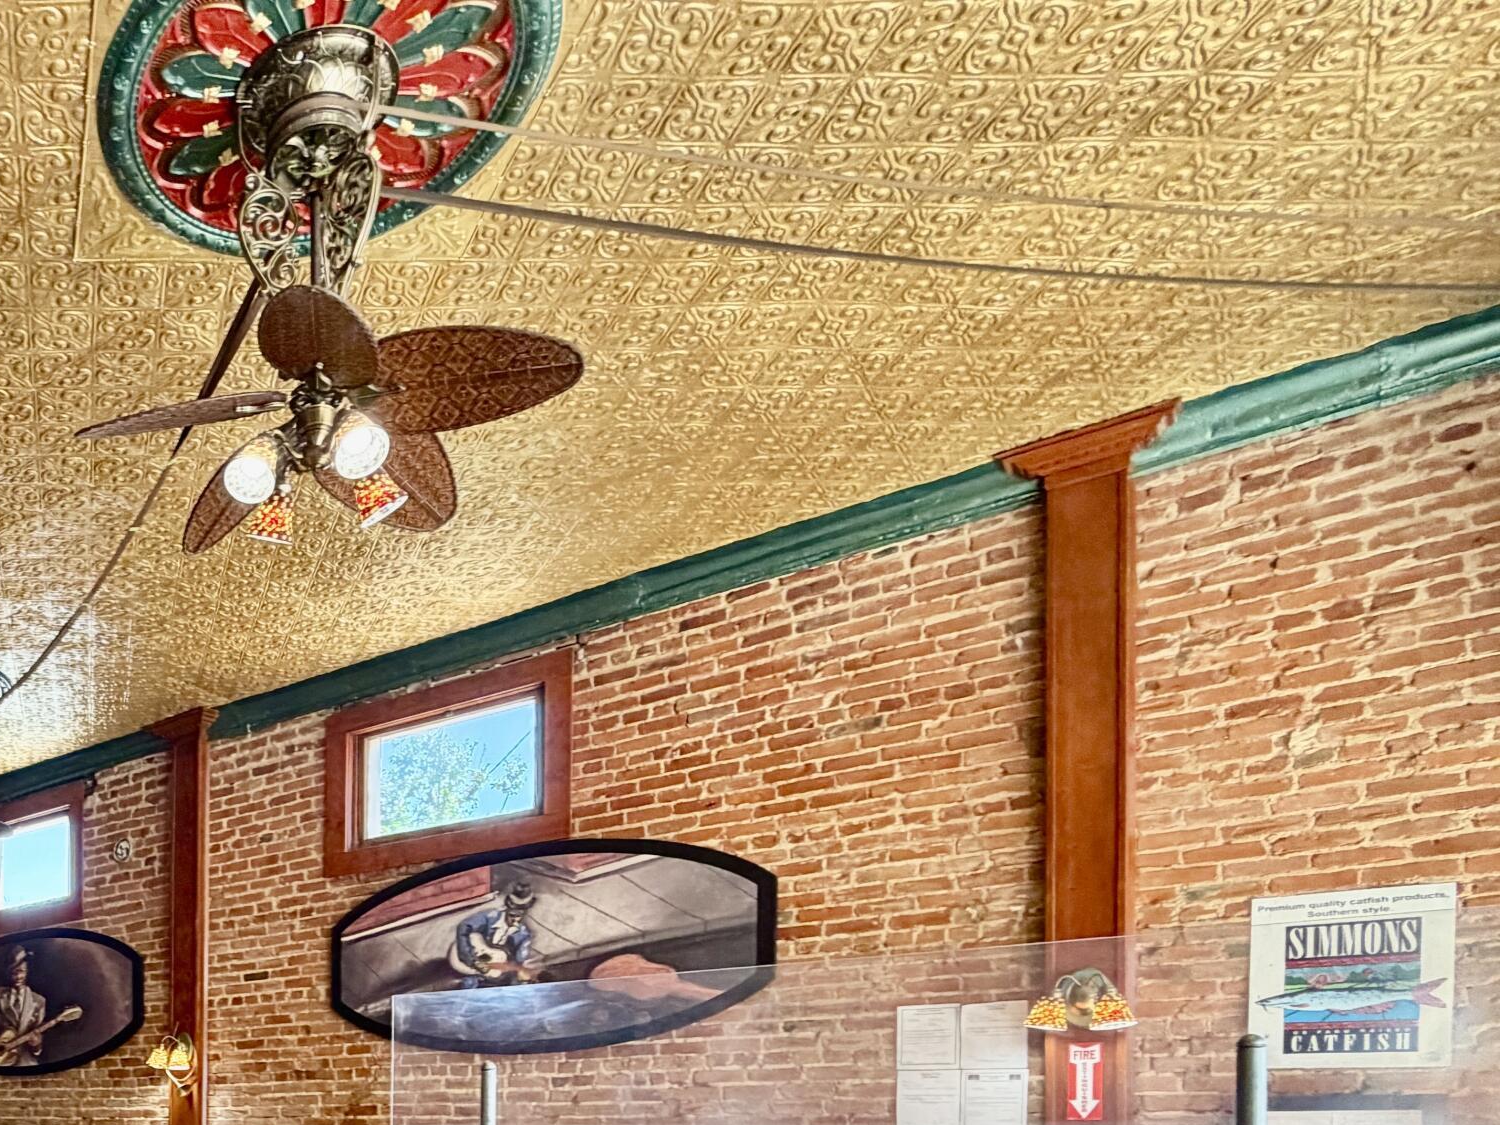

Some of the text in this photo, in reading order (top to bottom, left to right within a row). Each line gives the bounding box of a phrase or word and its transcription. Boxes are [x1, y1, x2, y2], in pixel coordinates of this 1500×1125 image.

[1257, 903, 1306, 912] Premium
[1308, 899, 1346, 909] quality
[1349, 896, 1389, 905] catfish
[1307, 908, 1359, 918] Southern
[1288, 919, 1418, 960] SIMMONS
[1290, 1032, 1411, 1052] CATFISH
[1073, 1050, 1097, 1060] FIRE
